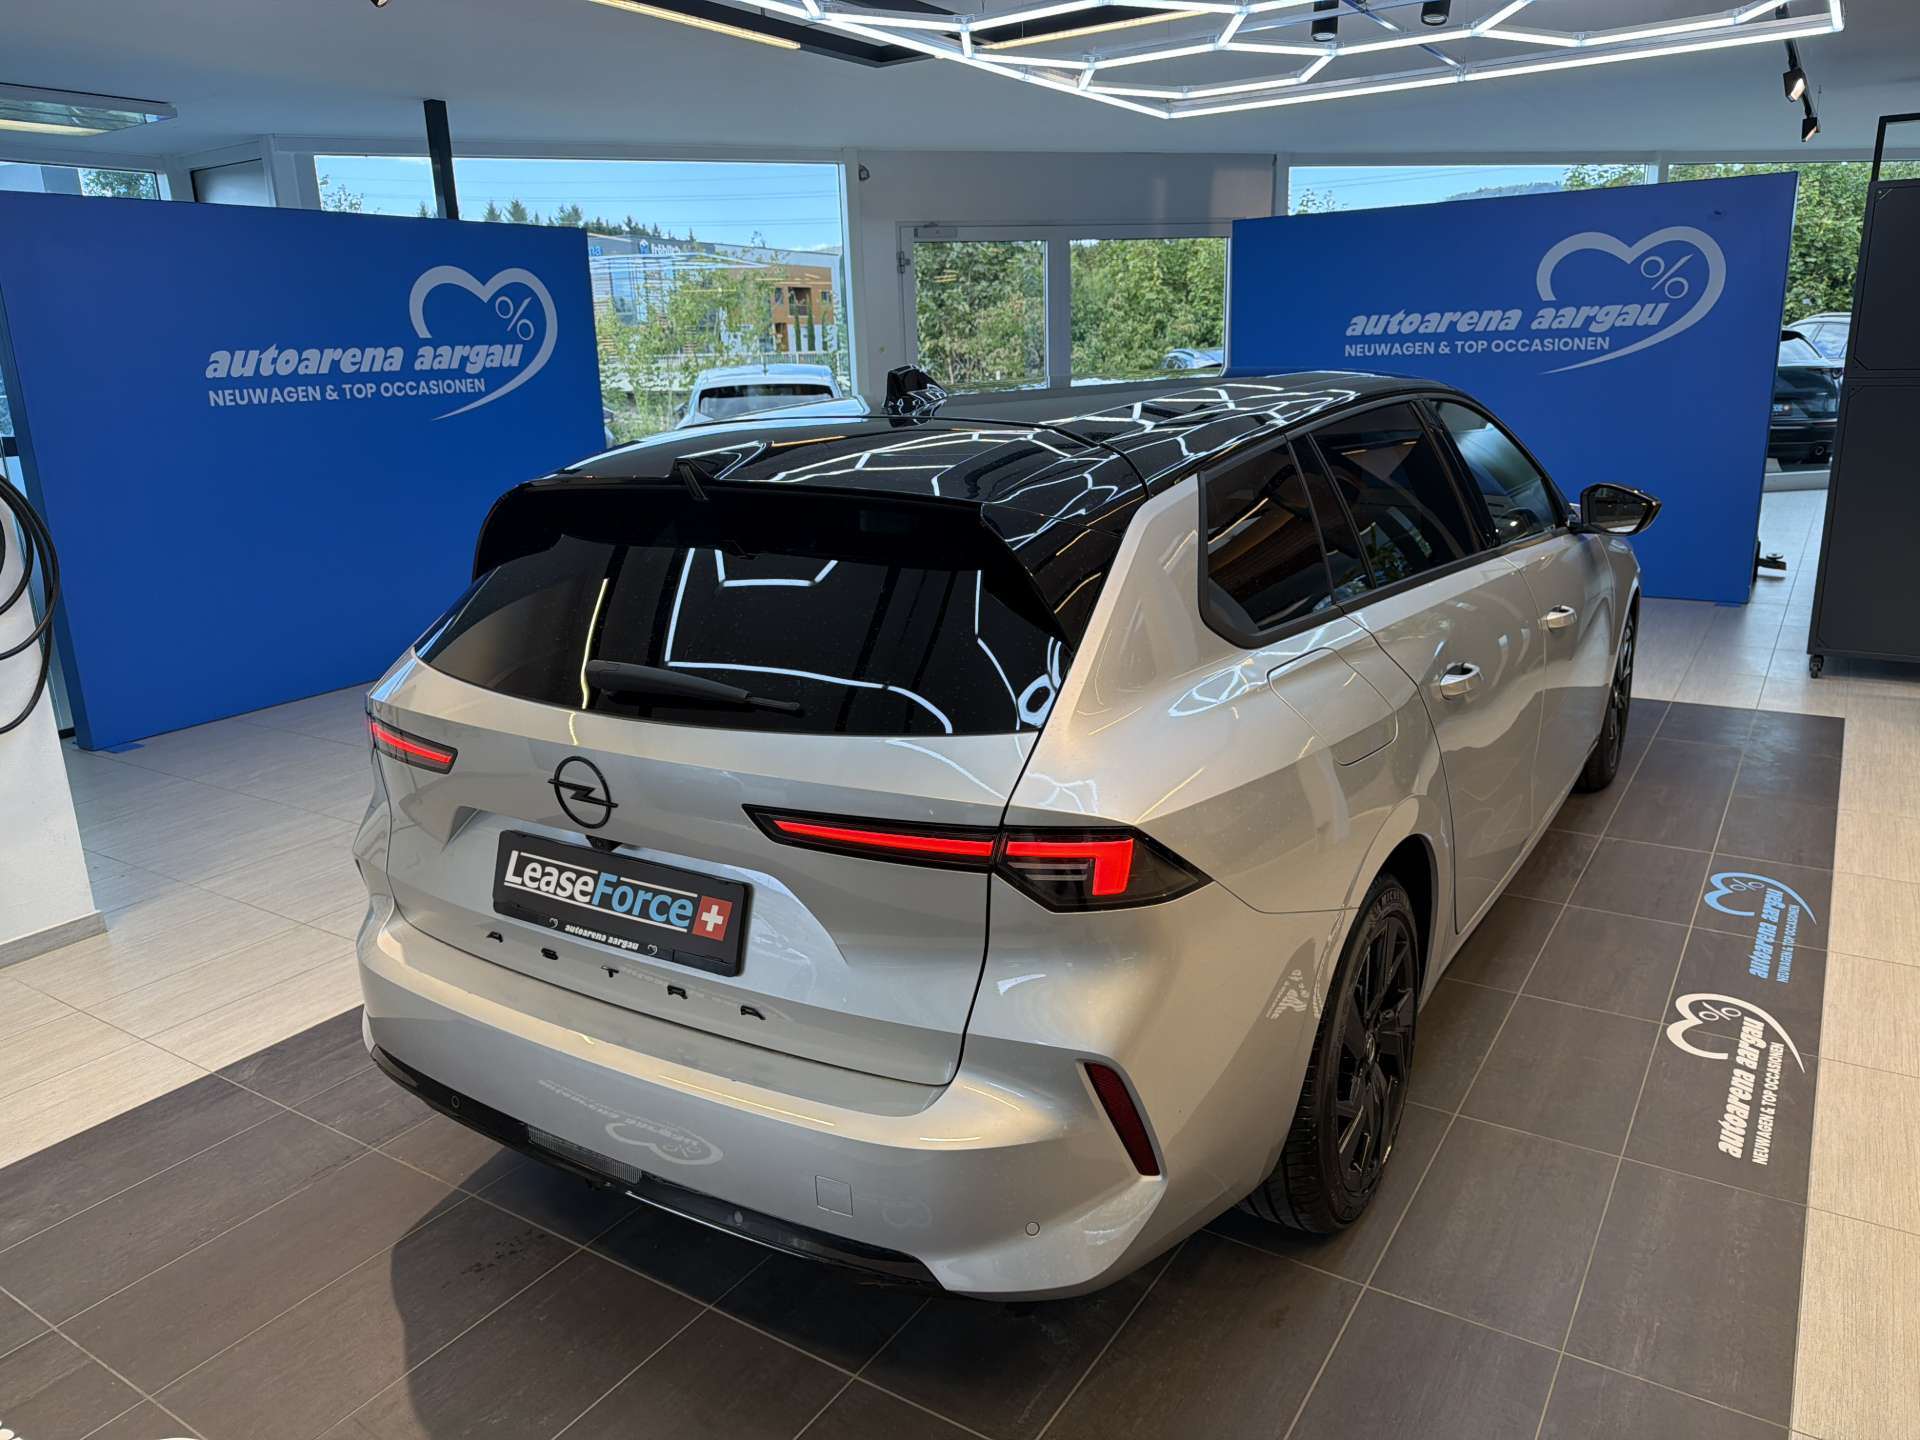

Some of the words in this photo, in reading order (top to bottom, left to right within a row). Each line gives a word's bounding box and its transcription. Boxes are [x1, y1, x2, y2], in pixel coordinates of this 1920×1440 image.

[1345, 308, 1523, 336] autoarena
[1530, 303, 1670, 333] aargau
[205, 343, 404, 379] autoarena
[414, 343, 523, 374] aargau
[1344, 341, 1435, 357] NEUWAGEN
[1438, 341, 1452, 354] &
[1455, 340, 1488, 353] TOP
[1491, 336, 1610, 353] OCCASIONEN
[208, 385, 321, 407] NEUWAGEN
[325, 384, 340, 400] &
[342, 382, 377, 399] TOP
[380, 378, 487, 398] OCCASIONEN
[504, 849, 694, 928] LeaseForce
[565, 924, 607, 943] autoarena
[608, 933, 639, 951] aargau
[1744, 921, 1777, 979] autoarena
[1761, 888, 1786, 923] aargau
[1735, 1016, 1767, 1070] aargau
[1764, 1041, 1785, 1091] OCCASIONEN
[1718, 1068, 1756, 1159] autoarena
[1760, 1105, 1776, 1115] &
[1761, 1089, 1778, 1106] TOP
[1751, 1114, 1775, 1166] NEUWAGEN
